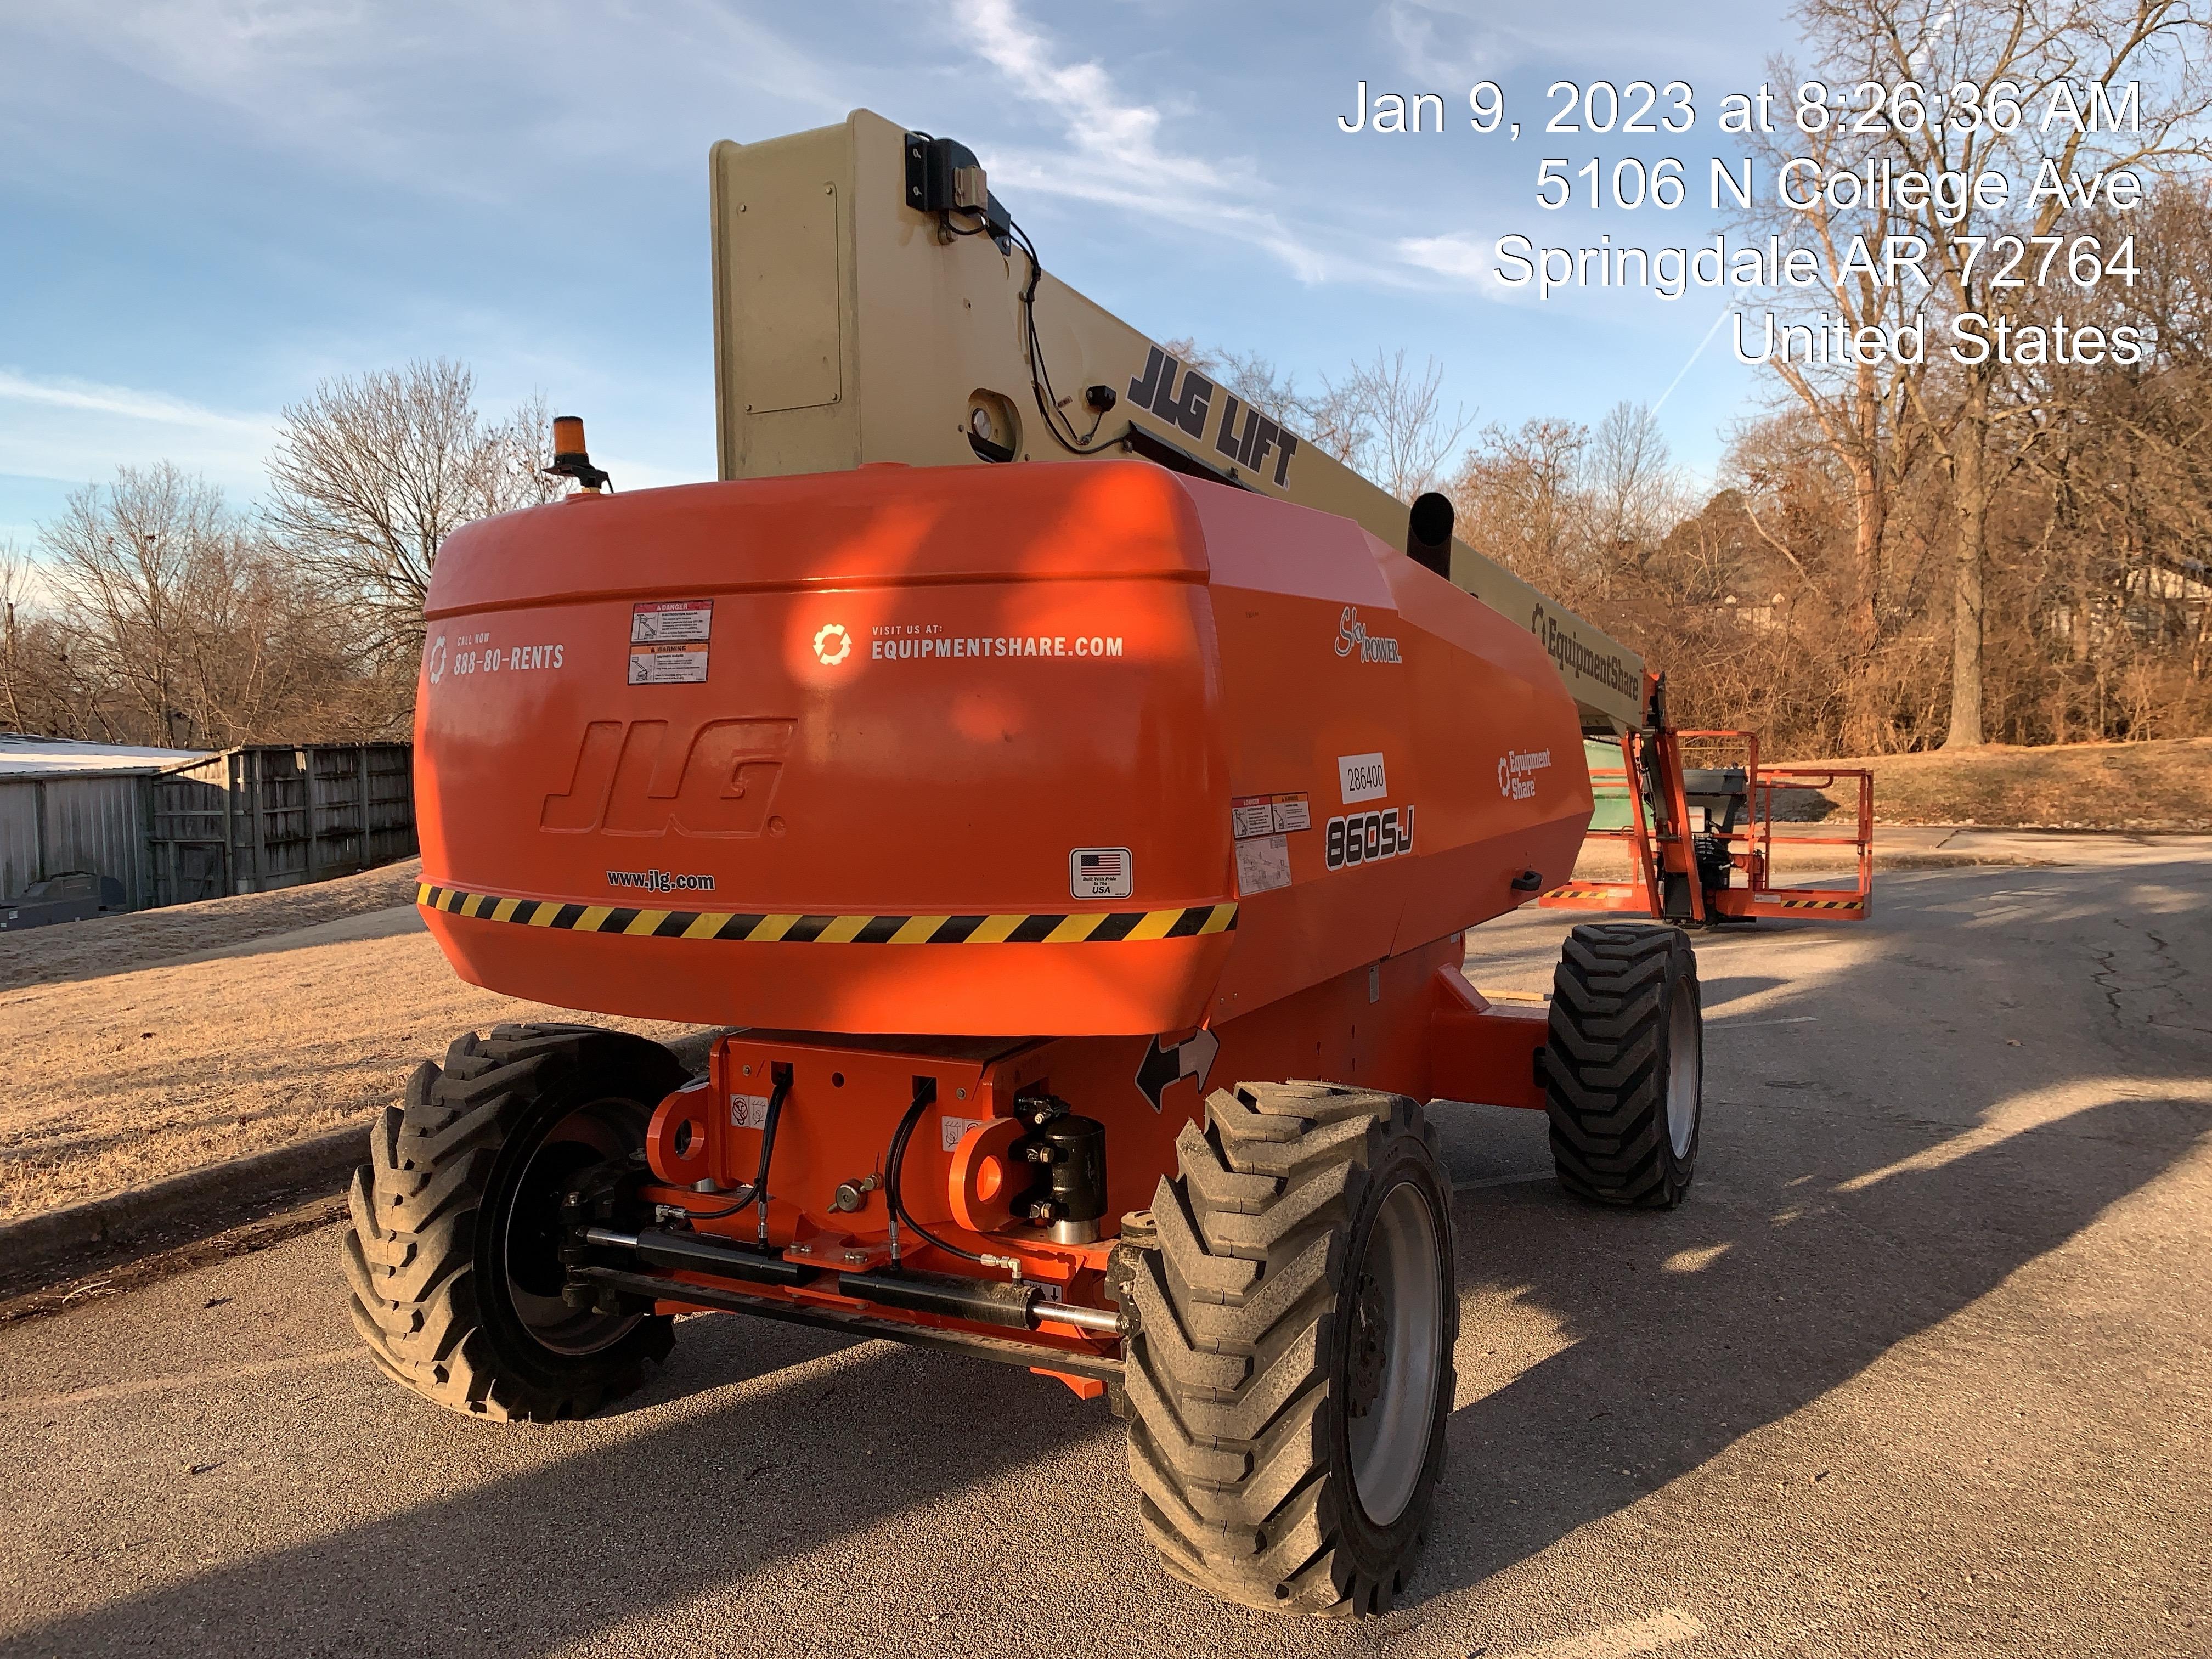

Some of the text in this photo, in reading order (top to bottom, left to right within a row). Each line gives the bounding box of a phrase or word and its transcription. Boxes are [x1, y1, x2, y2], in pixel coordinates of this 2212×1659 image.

[1125, 343, 1298, 487] JLG LIFT
[458, 633, 490, 646] CALL NOW
[872, 624, 943, 636] VISIT US AT:
[454, 644, 564, 675] 888-80-RENTS
[872, 637, 1124, 661] EQUIPMENTSHARE.COM
[1548, 617, 1638, 701] EquipmentShare
[1509, 748, 1551, 777] Equipment
[1347, 764, 1384, 792] 286400
[1511, 778, 1536, 800] Share
[1325, 805, 1414, 871] 860SJ
[606, 870, 715, 893] www.jlg.com
